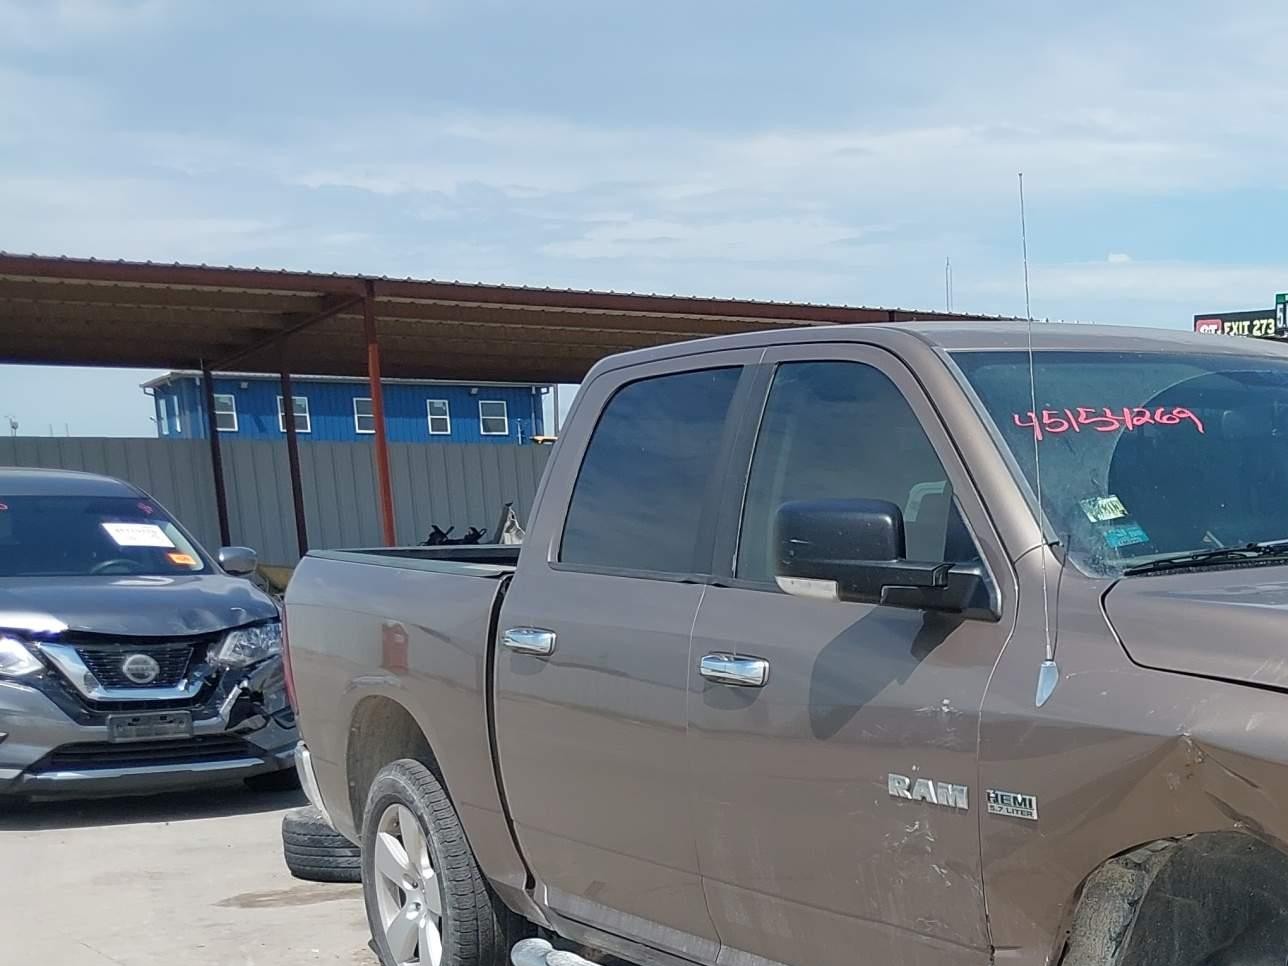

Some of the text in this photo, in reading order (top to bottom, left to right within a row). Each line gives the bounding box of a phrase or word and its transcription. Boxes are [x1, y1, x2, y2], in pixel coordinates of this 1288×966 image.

[1223, 320, 1251, 336] EXIT
[1253, 318, 1275, 336] 273
[1014, 407, 1205, 441] 45154269
[888, 773, 969, 811] RAM
[987, 790, 1035, 810] HEMI
[989, 804, 1034, 818] 5.7 LITER
